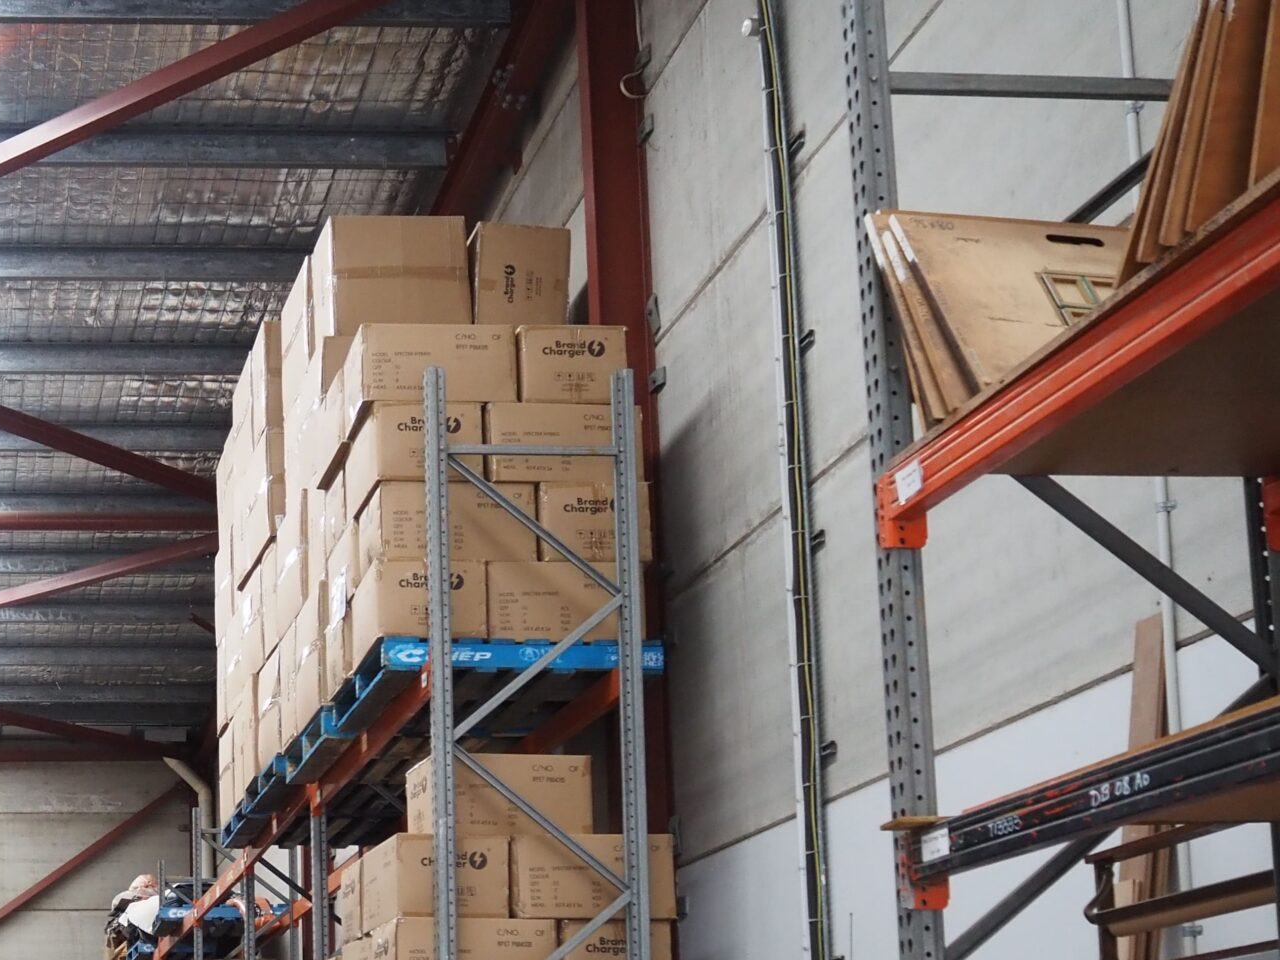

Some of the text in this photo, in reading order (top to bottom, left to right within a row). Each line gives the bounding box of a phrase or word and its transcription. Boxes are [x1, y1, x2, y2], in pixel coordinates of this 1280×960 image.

[555, 340, 586, 349] Brand
[542, 347, 586, 358] Charger
[577, 497, 608, 506] Brand
[563, 504, 609, 515] Charger
